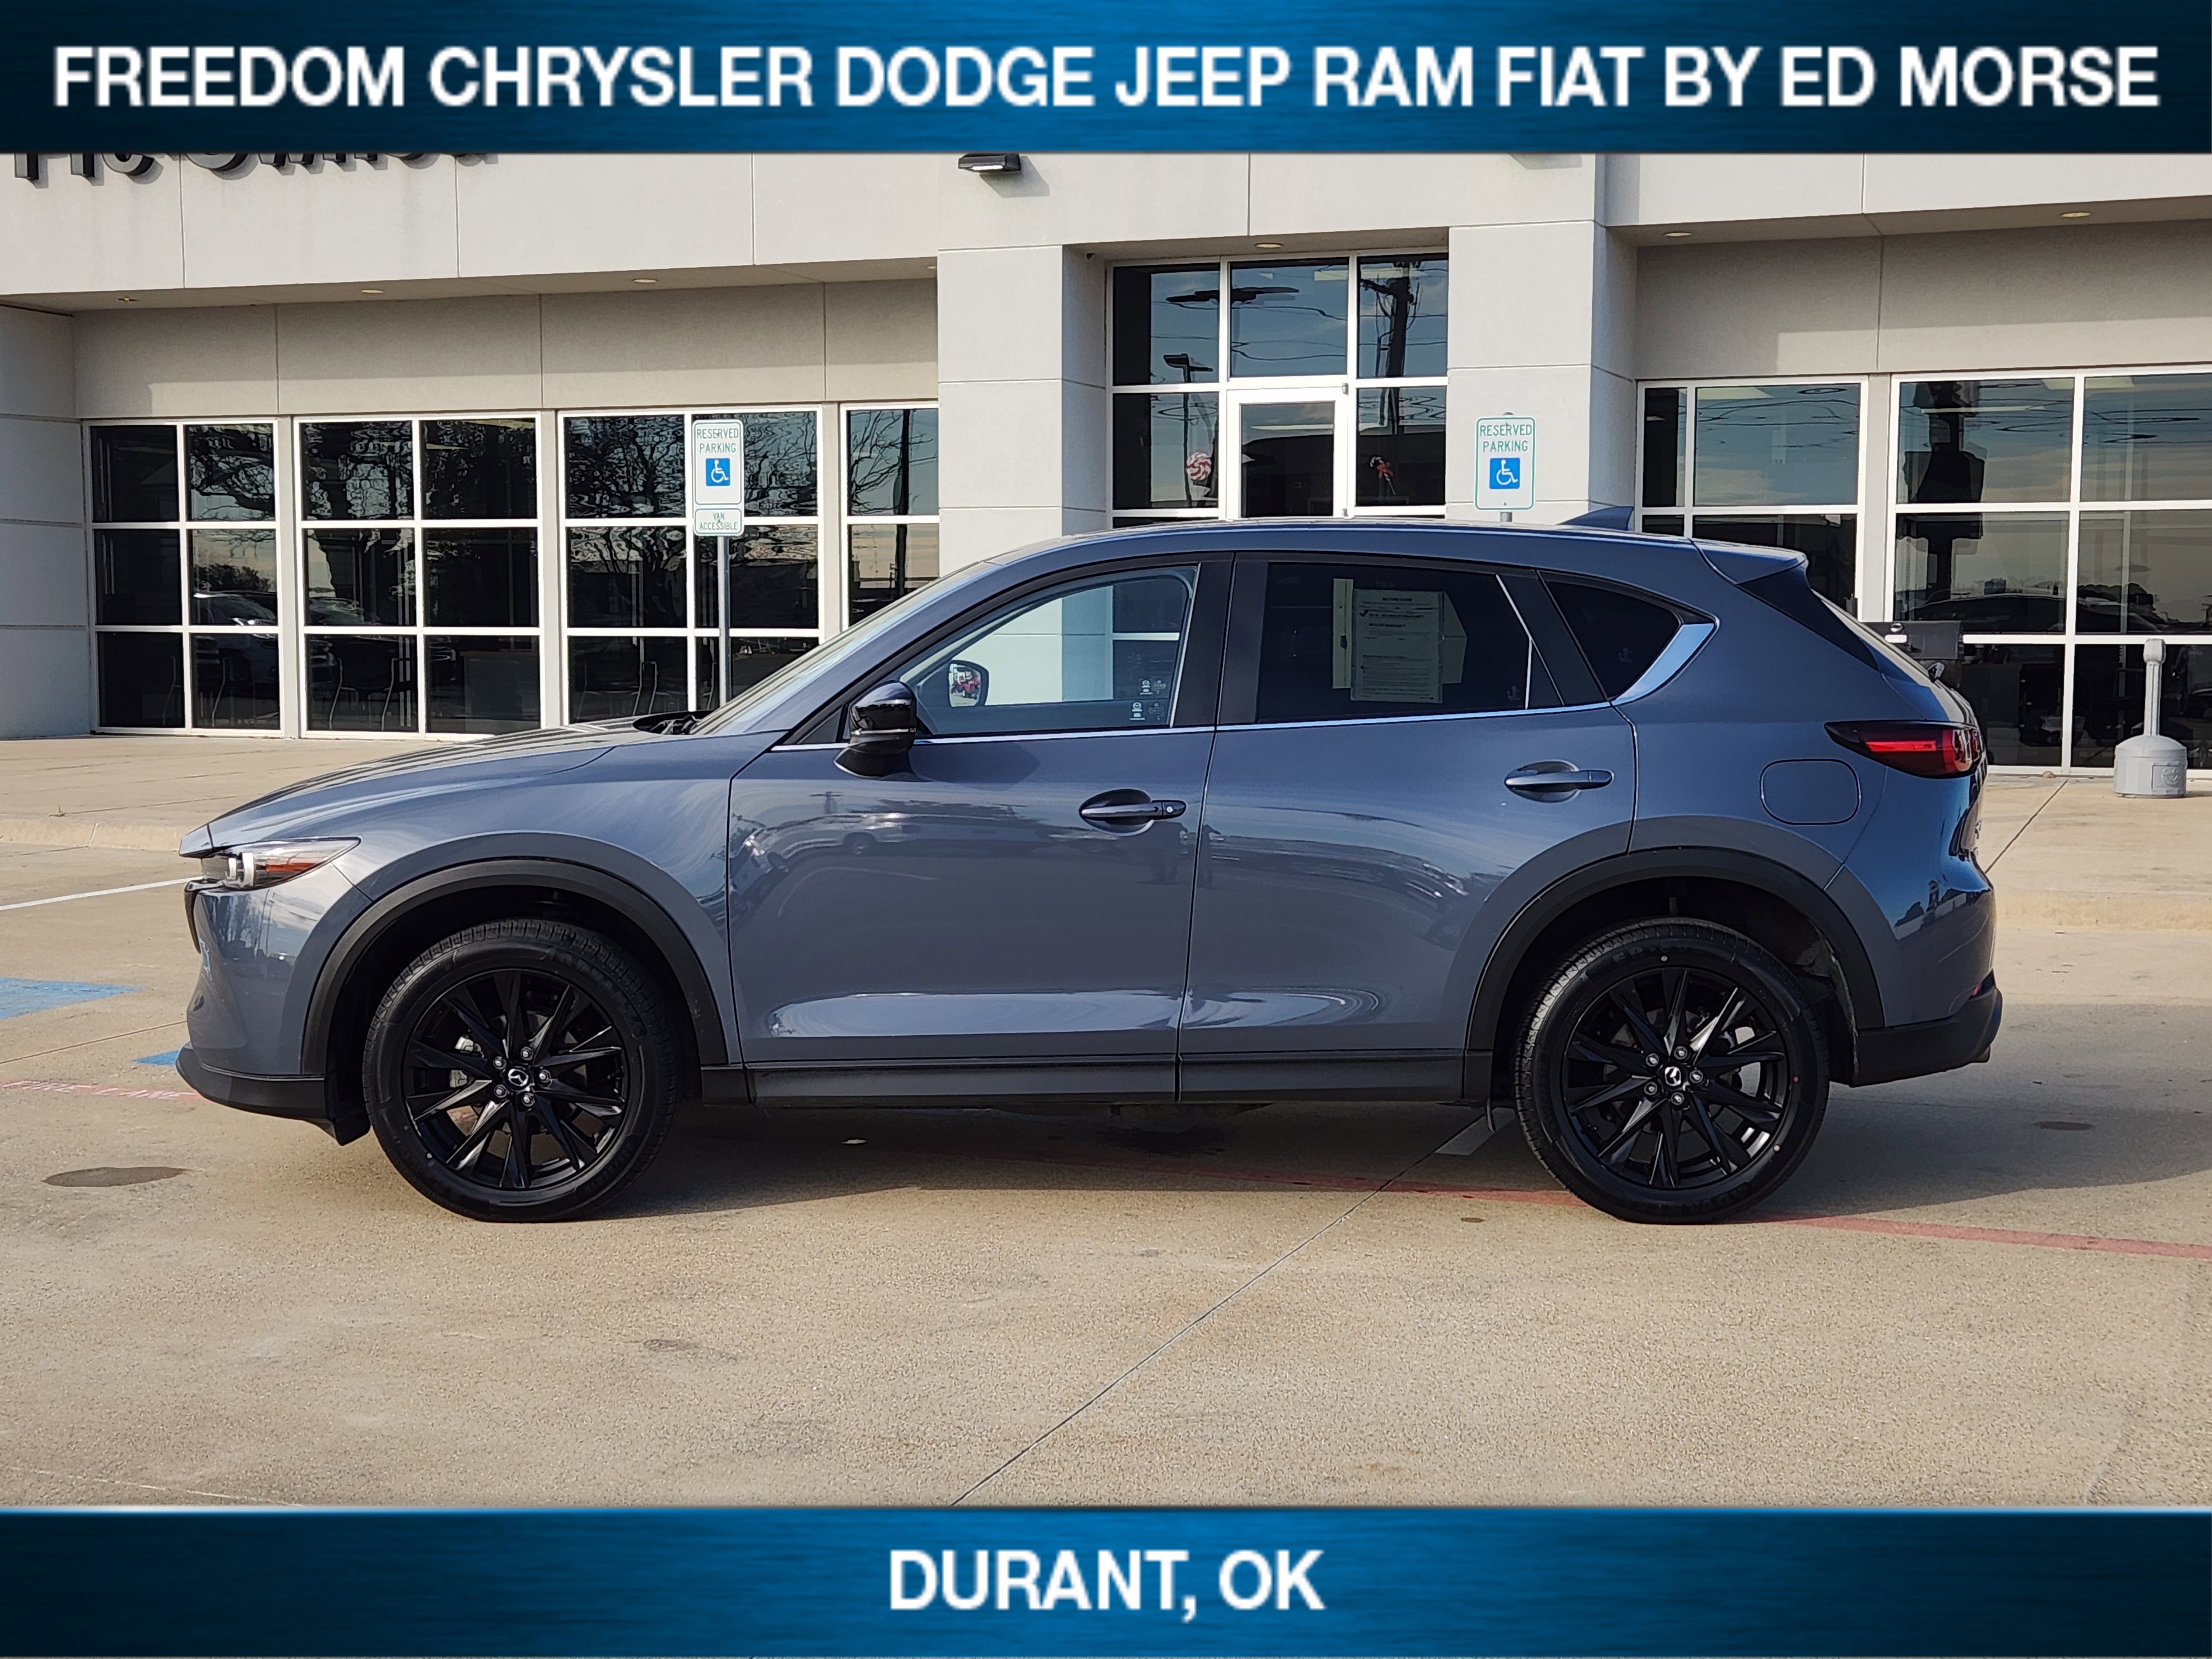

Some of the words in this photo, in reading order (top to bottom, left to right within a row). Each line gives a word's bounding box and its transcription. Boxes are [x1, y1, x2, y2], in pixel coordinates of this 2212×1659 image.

[697, 428, 739, 439] RESERVED
[1479, 424, 1532, 436] RESERVED
[699, 442, 737, 453] PARKING
[1483, 440, 1528, 452] PARKING
[712, 512, 725, 520] VAN
[699, 521, 738, 530] ACCESSIBLE
